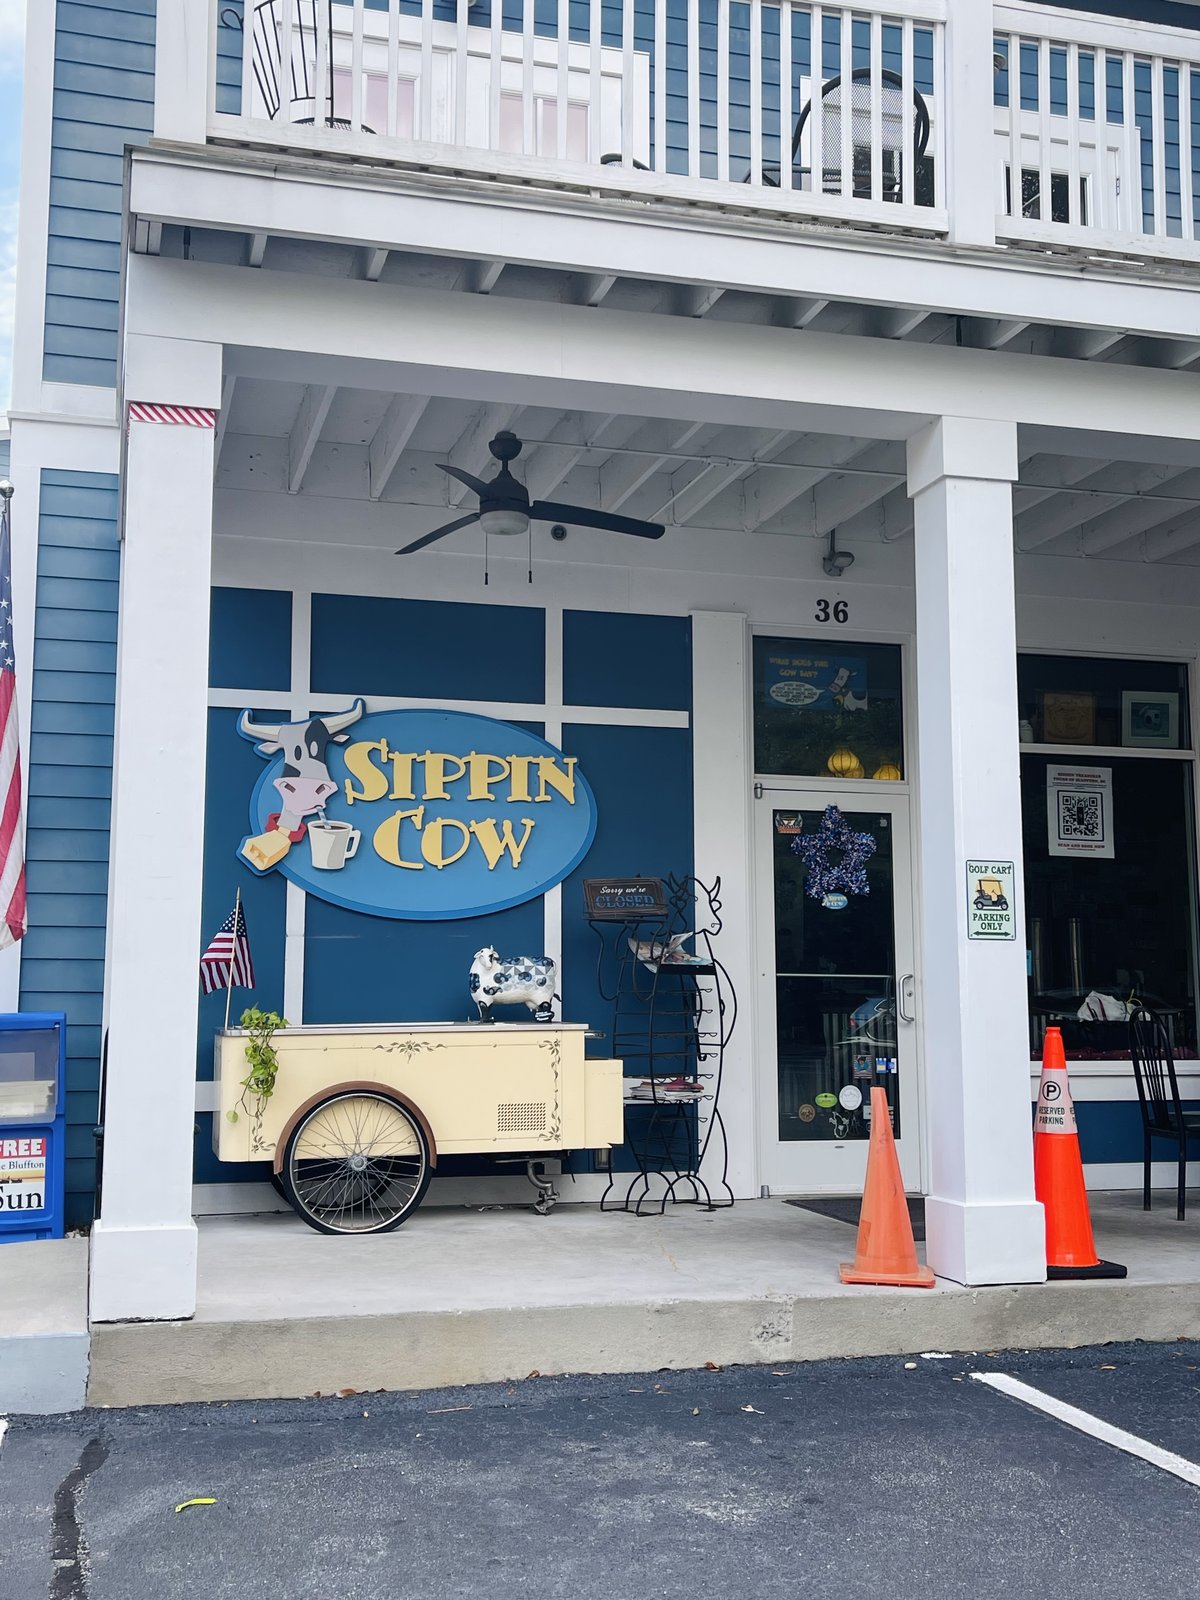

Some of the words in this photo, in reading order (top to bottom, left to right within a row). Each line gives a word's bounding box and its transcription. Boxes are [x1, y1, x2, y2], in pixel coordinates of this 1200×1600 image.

[814, 599, 848, 623] 36
[968, 865, 989, 873] GOLF
[991, 866, 1011, 874] CART
[600, 885, 624, 896] Sorry
[625, 885, 647, 894] we're
[595, 894, 655, 908] CLOSED
[973, 913, 1010, 921] PARKING
[980, 922, 1003, 930] ONLY
[1038, 1106, 1065, 1115] RESERVED
[1039, 1116, 1064, 1125] PARKING
[9, 1160, 45, 1170] Bluffton
